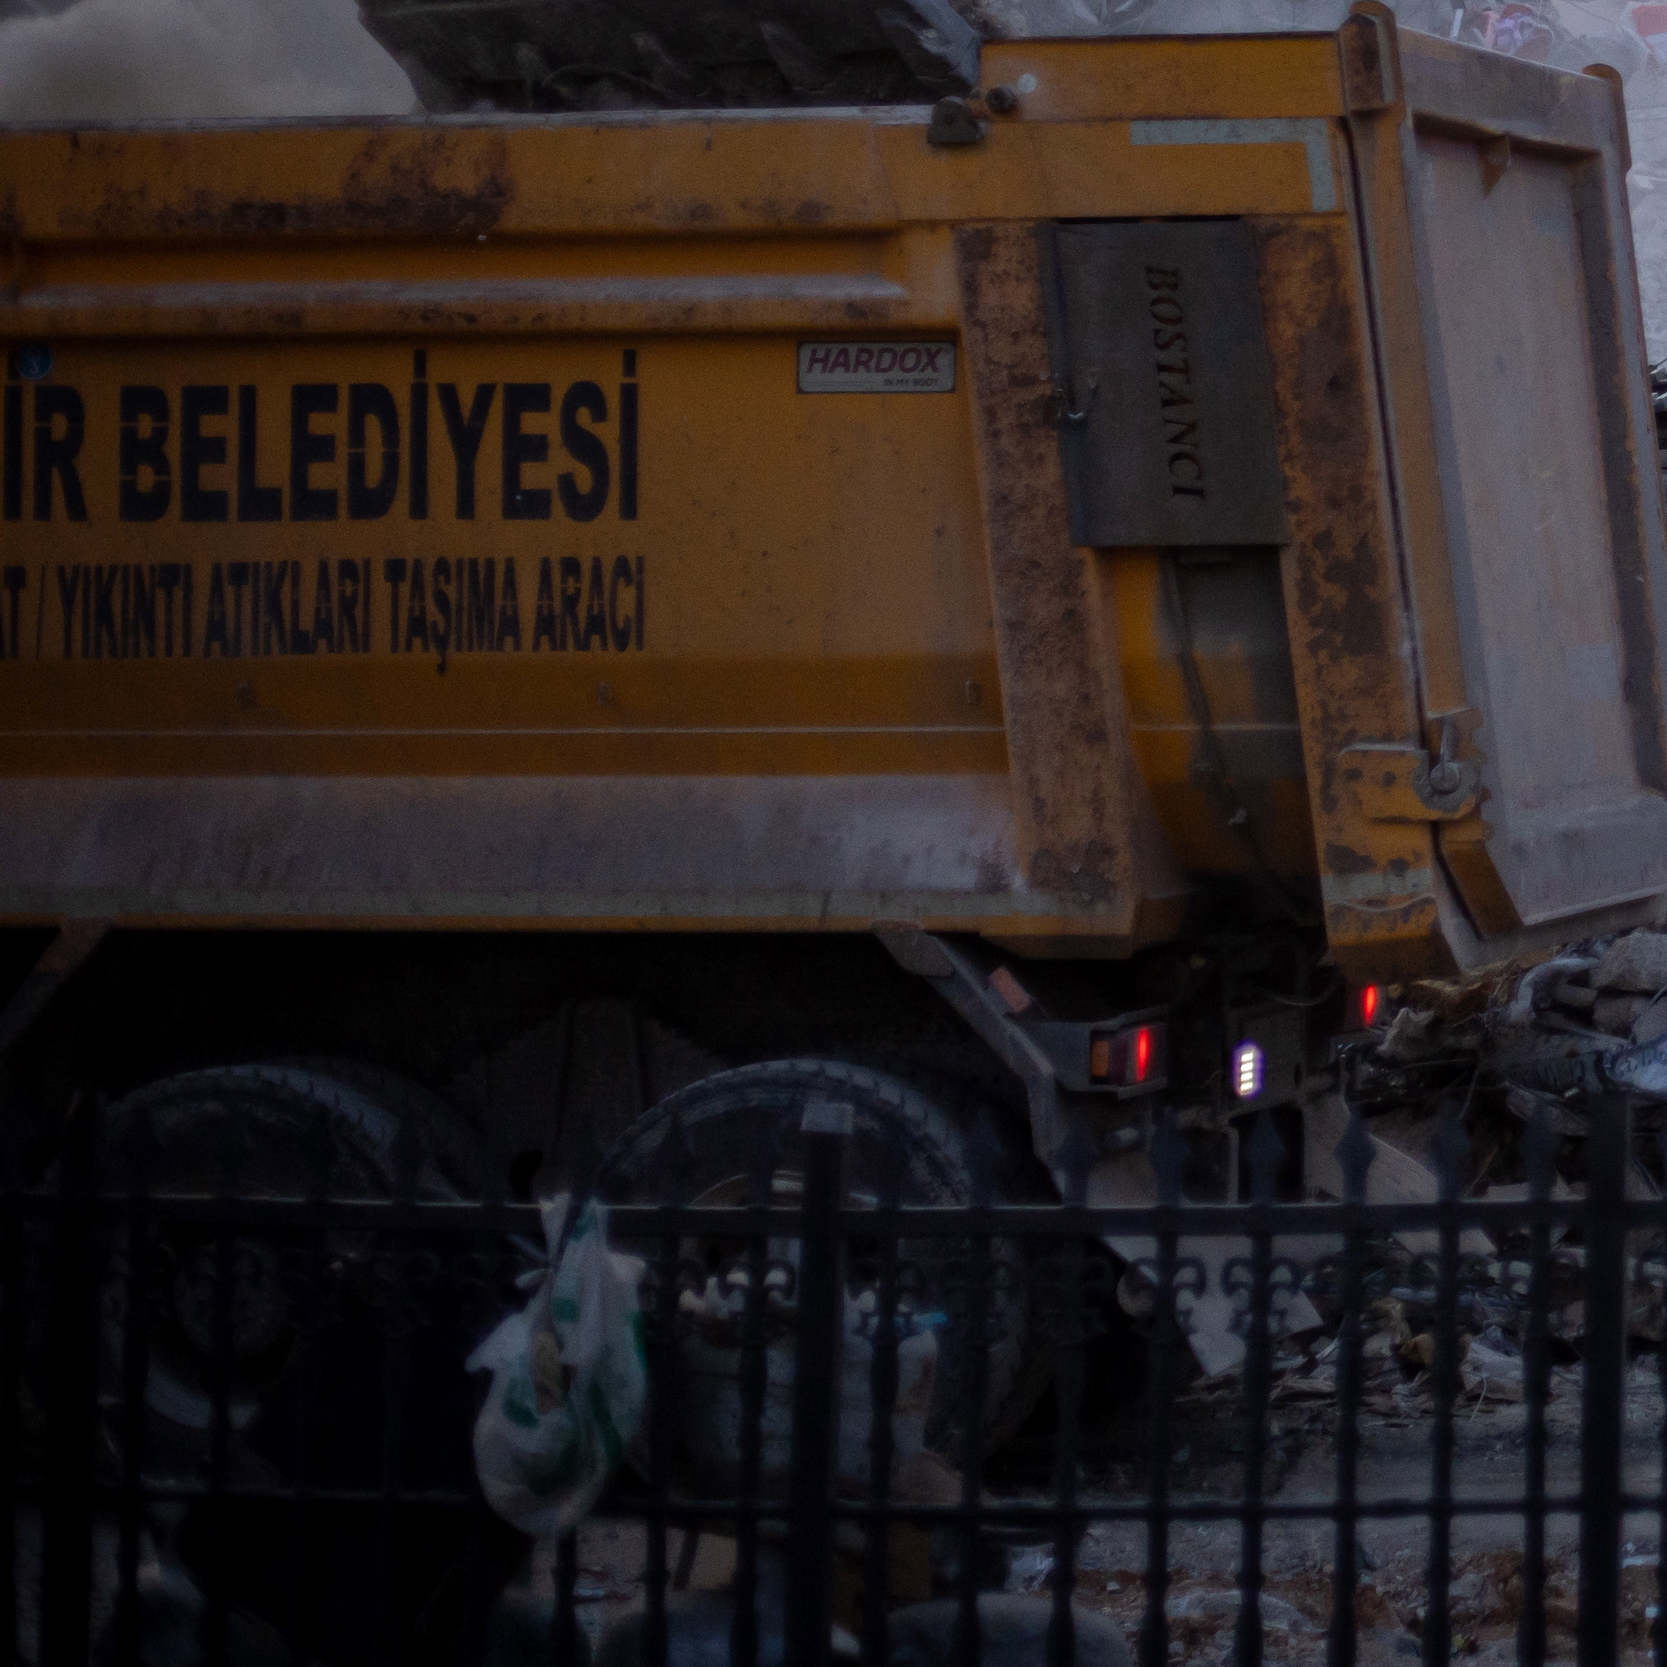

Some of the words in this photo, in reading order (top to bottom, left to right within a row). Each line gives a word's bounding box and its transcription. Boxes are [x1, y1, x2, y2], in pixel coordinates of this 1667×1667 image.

[806, 346, 943, 374] HARDOX
[1144, 263, 1208, 503] BOSTANCI
[119, 349, 641, 523] BELEDİYESİ
[57, 563, 194, 660] YIKINTI
[203, 559, 372, 659] ATIKLARI
[384, 555, 522, 676] TAŞIMA
[531, 554, 646, 655] ARACI
